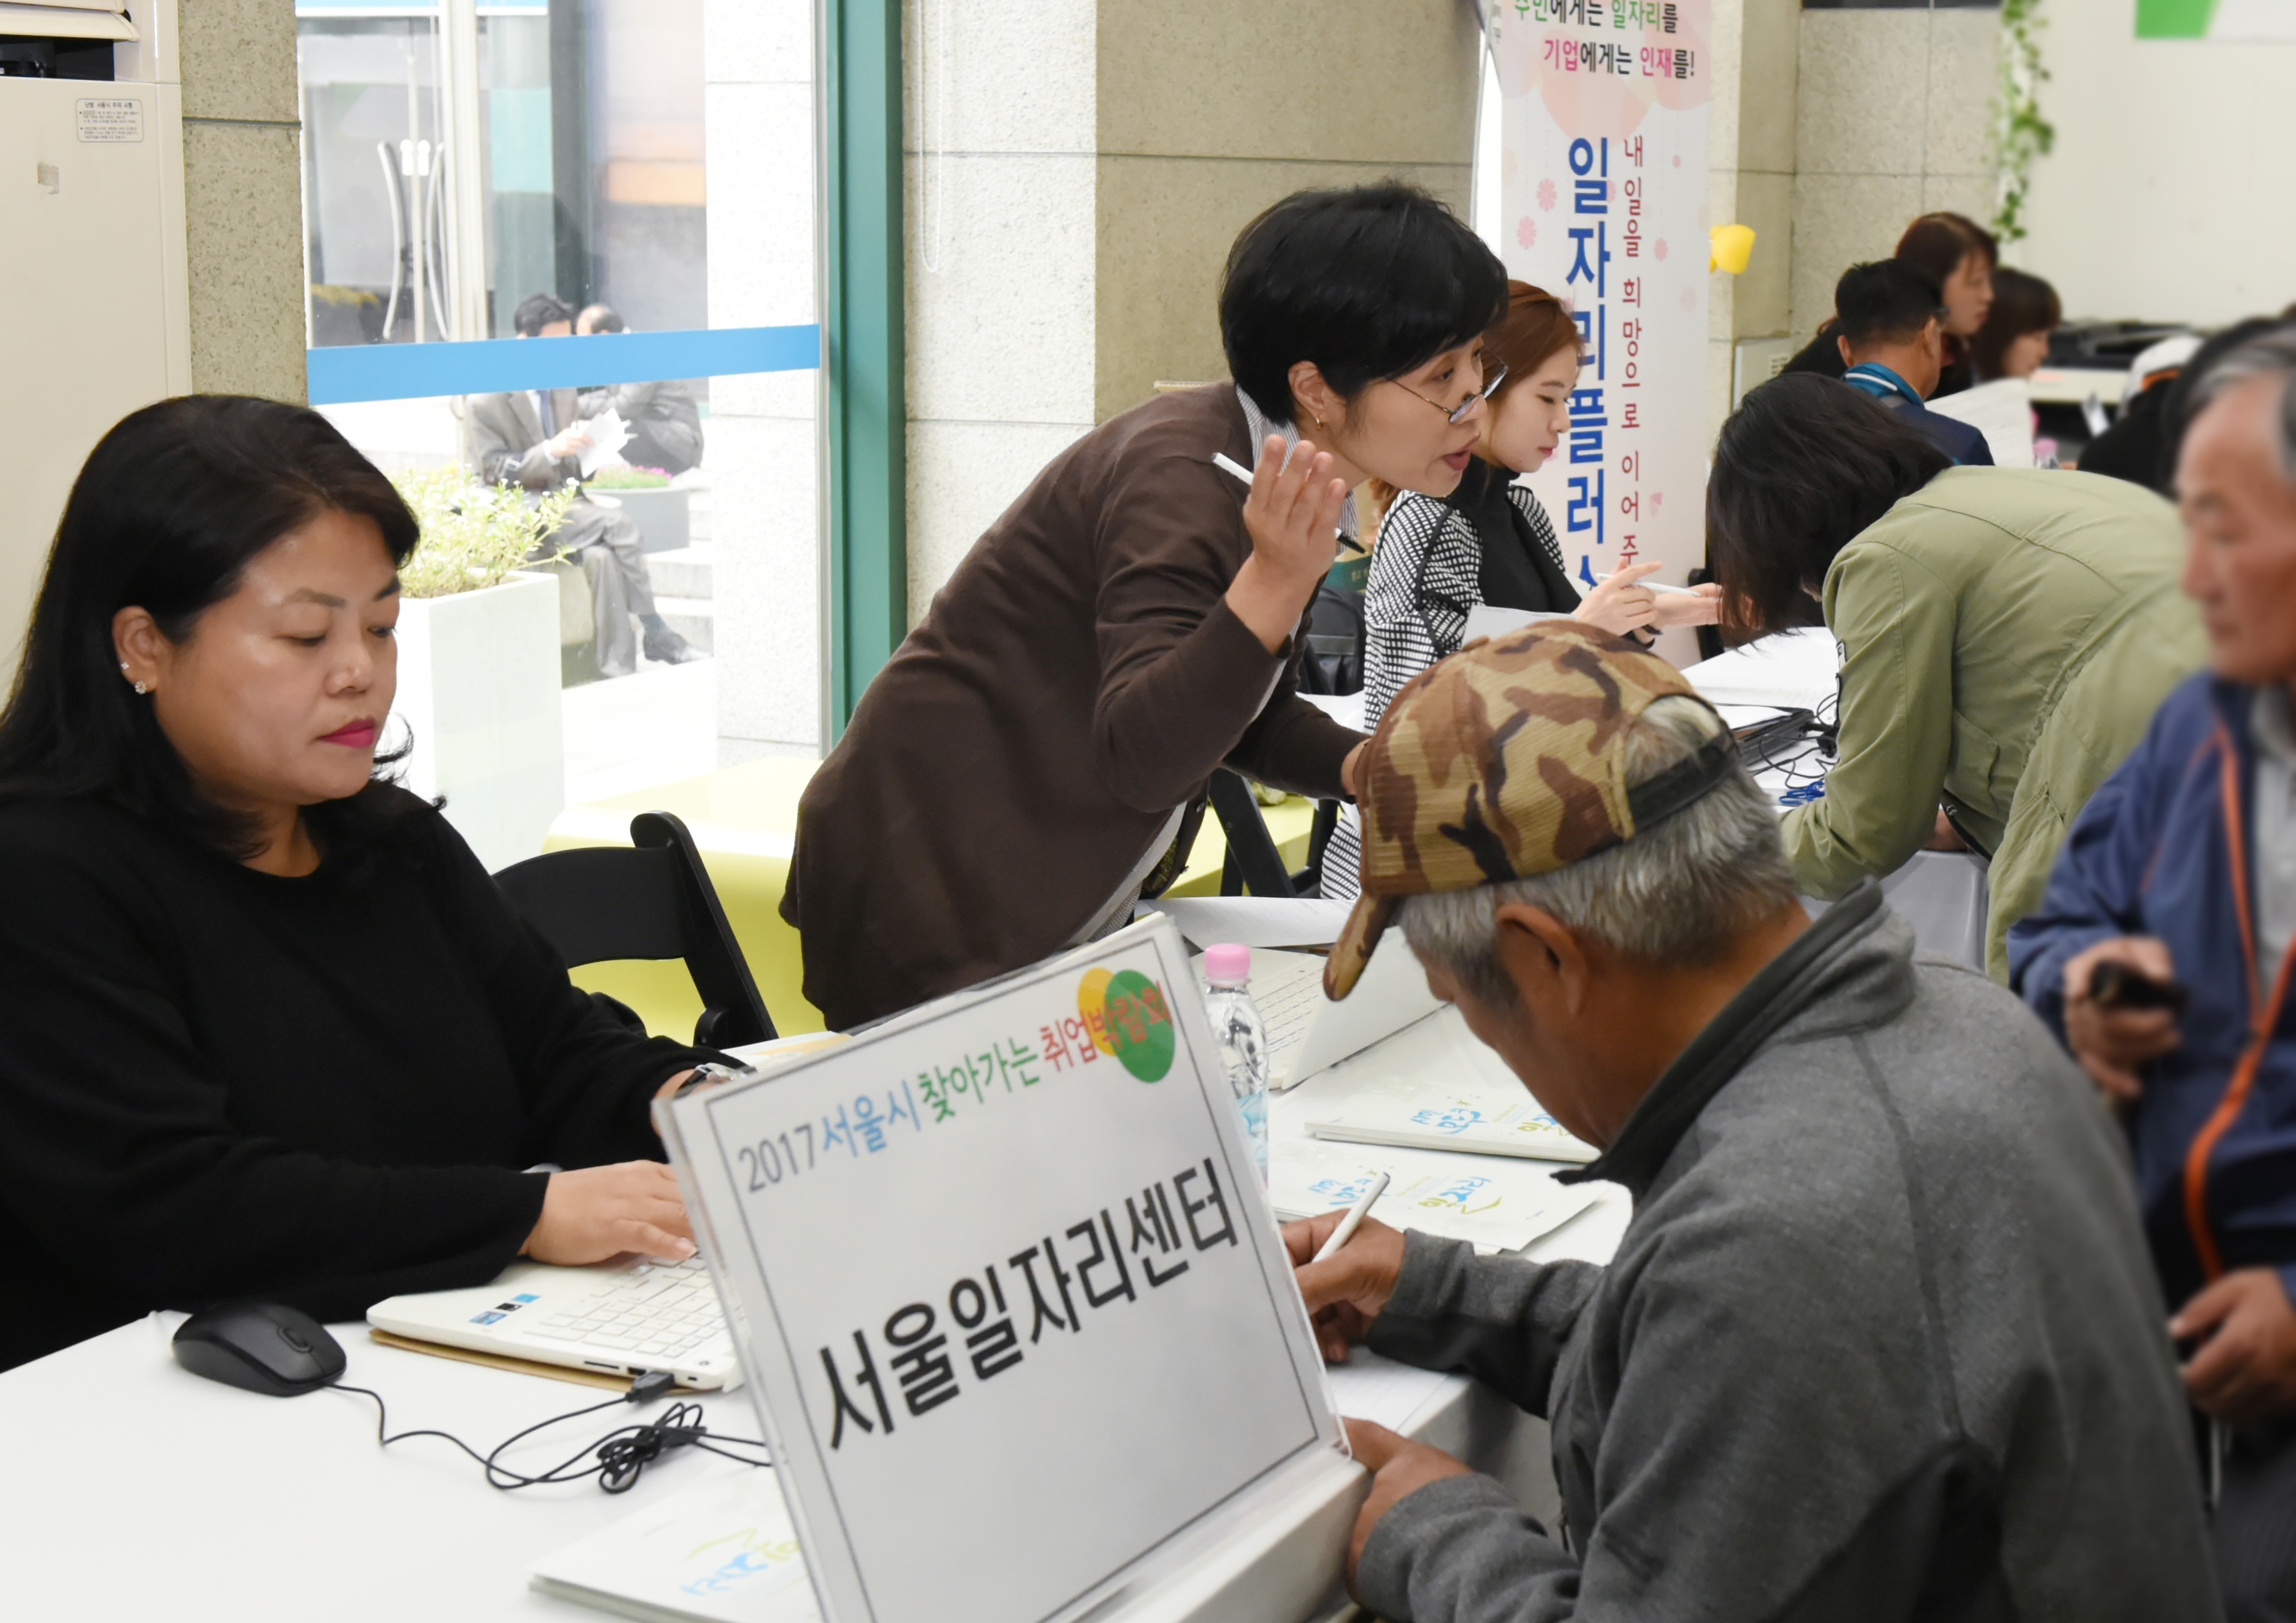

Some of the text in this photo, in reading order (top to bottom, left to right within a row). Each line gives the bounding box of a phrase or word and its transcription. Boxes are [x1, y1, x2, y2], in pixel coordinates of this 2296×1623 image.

[1514, 0, 1604, 27] 주민에게는
[1611, 0, 1679, 33] 일자리를
[1544, 39, 1695, 79] 기업에게는 인재를!
[1621, 276, 1642, 429] 희망으로
[822, 1080, 921, 1157] 서울시
[917, 1037, 1041, 1124] 찾아가는
[1039, 980, 1173, 1072] 취업박람회
[818, 1157, 1239, 1451] 서울일자리센터
